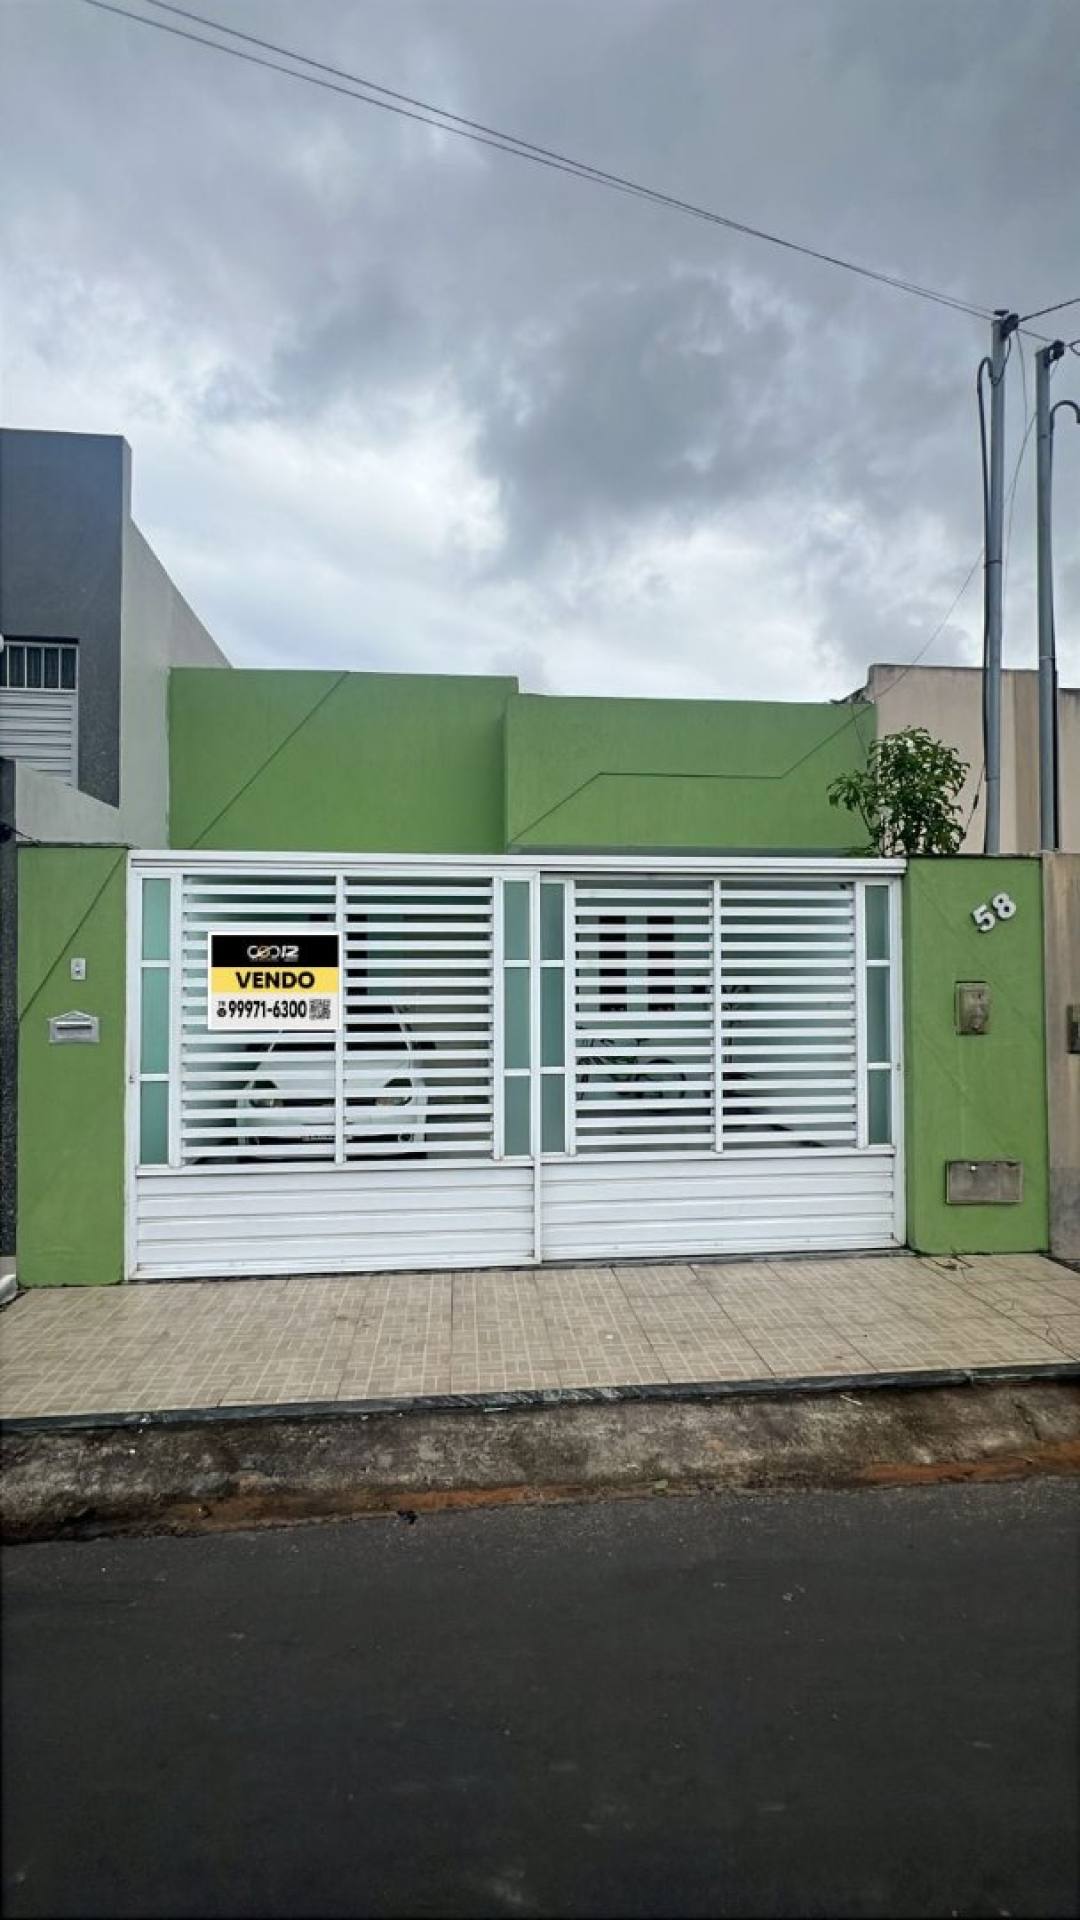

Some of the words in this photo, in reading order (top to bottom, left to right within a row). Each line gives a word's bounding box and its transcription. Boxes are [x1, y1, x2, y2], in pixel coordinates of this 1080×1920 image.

[972, 892, 1017, 931] 58
[235, 971, 315, 989] VENDO
[228, 1000, 307, 1018] 99971-6300
